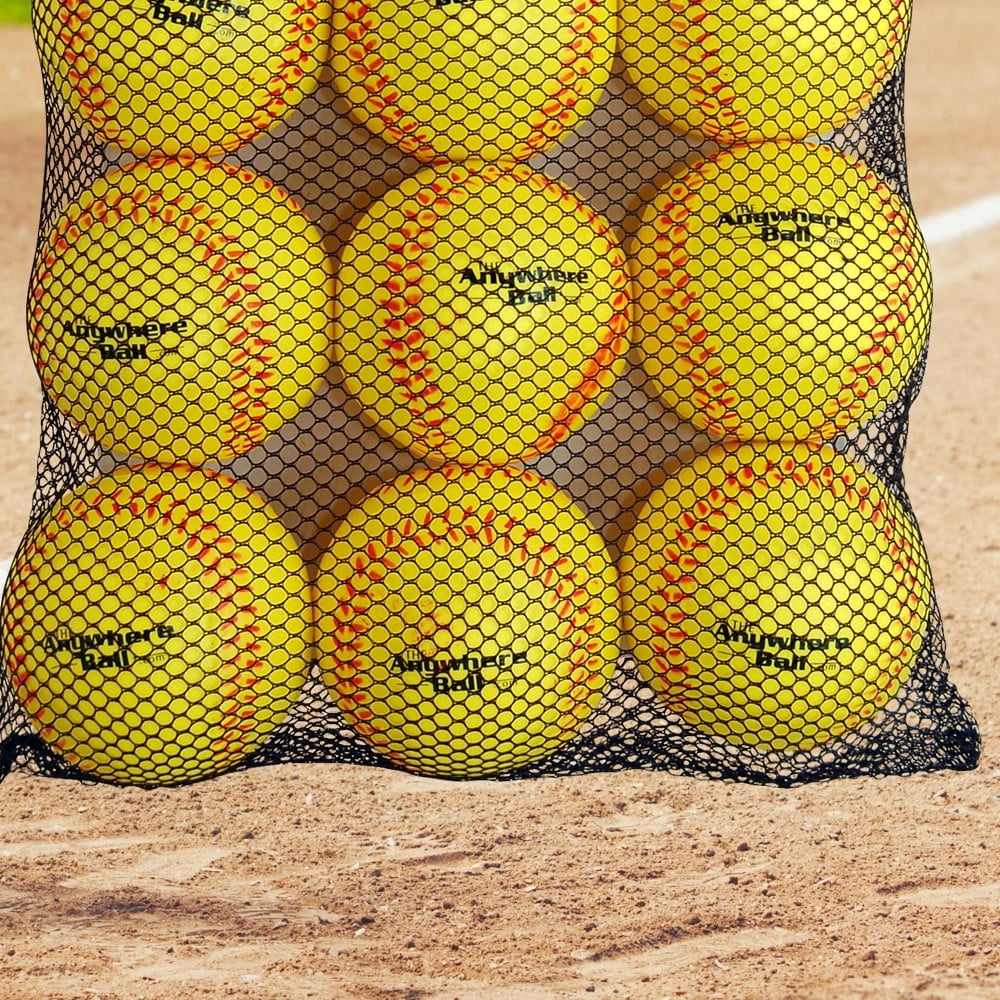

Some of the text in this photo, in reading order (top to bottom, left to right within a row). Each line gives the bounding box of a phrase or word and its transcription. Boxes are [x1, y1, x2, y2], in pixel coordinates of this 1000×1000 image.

[152, 4, 204, 29] Ball
[717, 208, 851, 228] Anywhere
[762, 227, 811, 242] Ball
[459, 266, 589, 288] Anywhere
[508, 286, 556, 305] Ball
[64, 320, 188, 343] Anywhere
[100, 343, 147, 359] Ball
[44, 626, 174, 653] Anywhere
[715, 623, 850, 650] Anywhere
[81, 650, 130, 671] Ball
[391, 651, 527, 676] Anywhere
[755, 650, 806, 670] Ball
[433, 673, 483, 692] Ball
